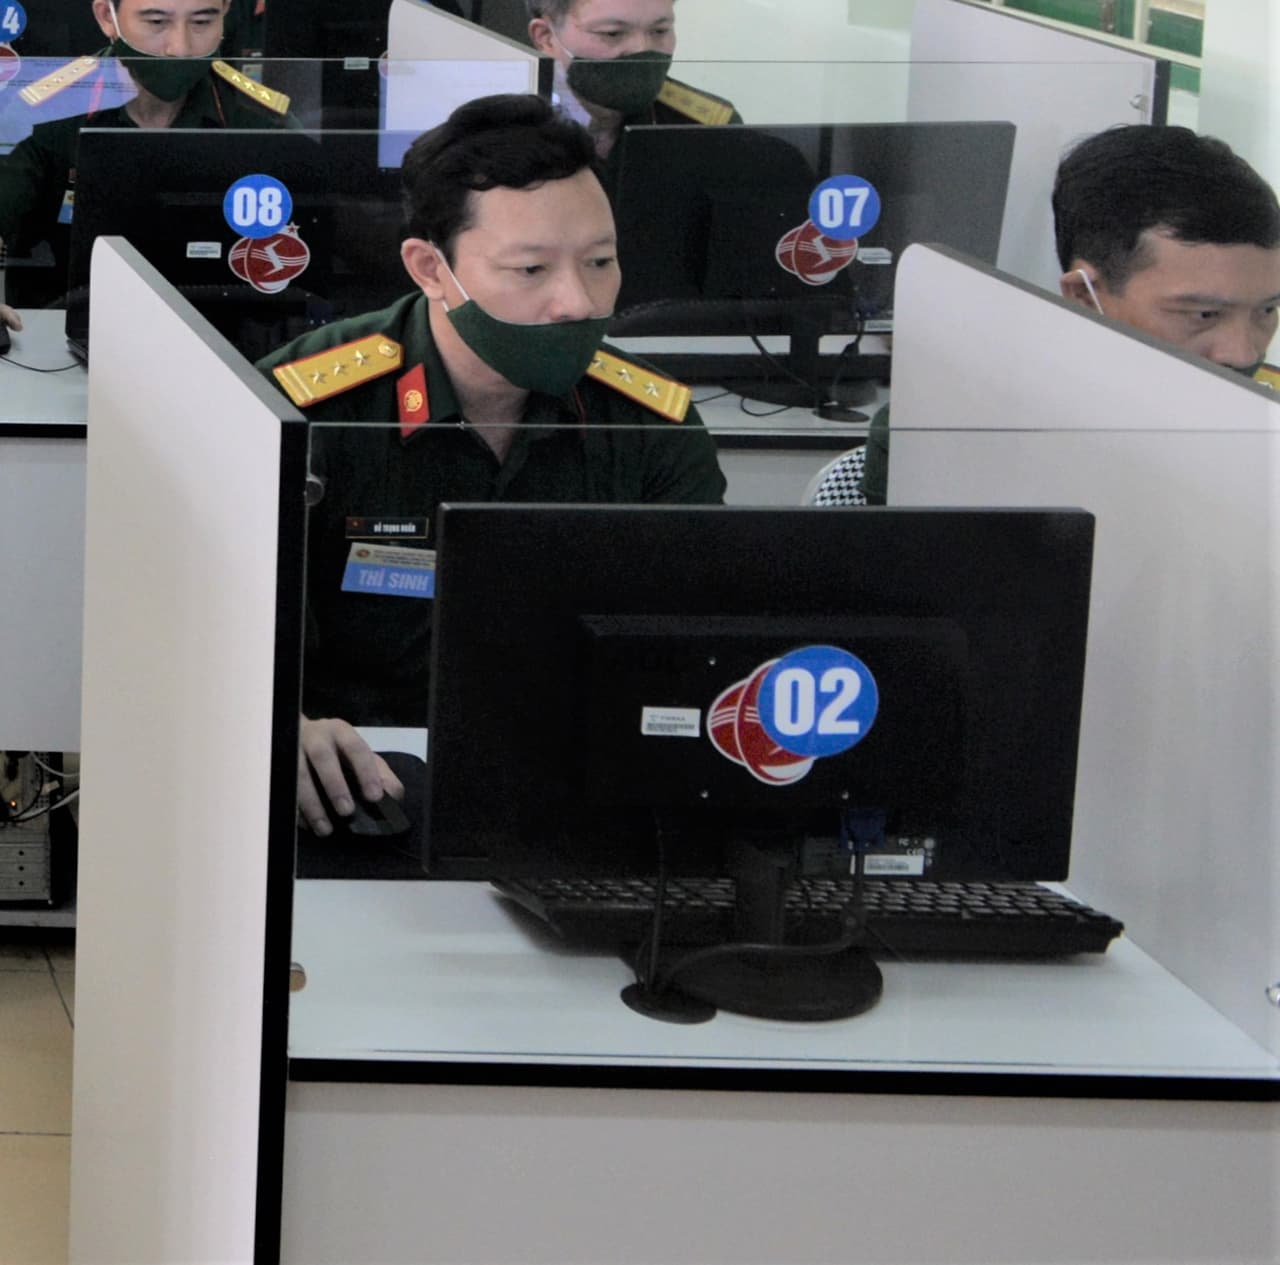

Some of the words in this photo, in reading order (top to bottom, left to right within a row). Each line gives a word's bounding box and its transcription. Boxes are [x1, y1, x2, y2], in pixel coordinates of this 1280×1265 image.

[232, 187, 283, 227] 08
[818, 186, 870, 229] 07
[358, 567, 387, 587] THÍ
[387, 571, 429, 592] SINH
[774, 667, 862, 736] 02
